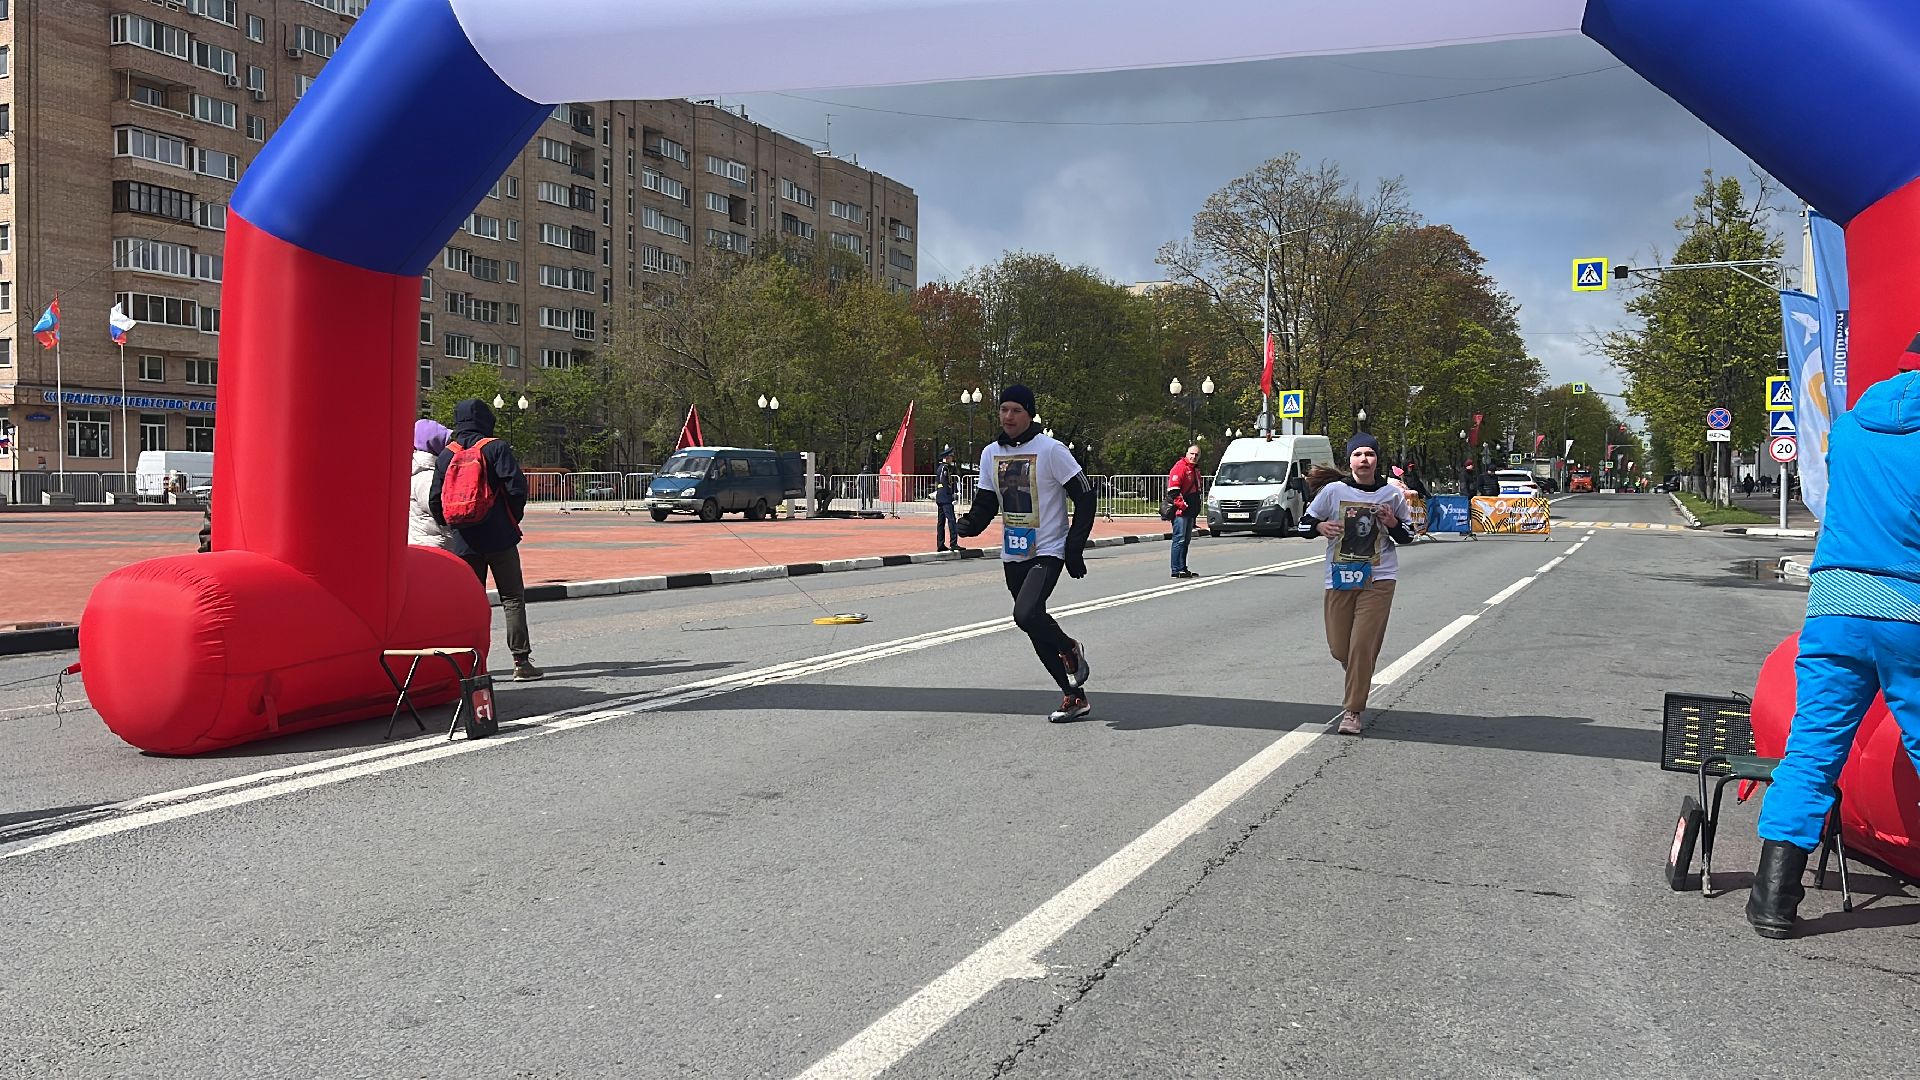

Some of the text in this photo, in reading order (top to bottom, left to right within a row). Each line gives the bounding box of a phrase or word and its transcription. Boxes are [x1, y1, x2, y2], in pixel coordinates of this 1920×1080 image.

[1776, 443, 1793, 454] 20
[1008, 535, 1027, 549] 138
[1340, 570, 1363, 583] 139
